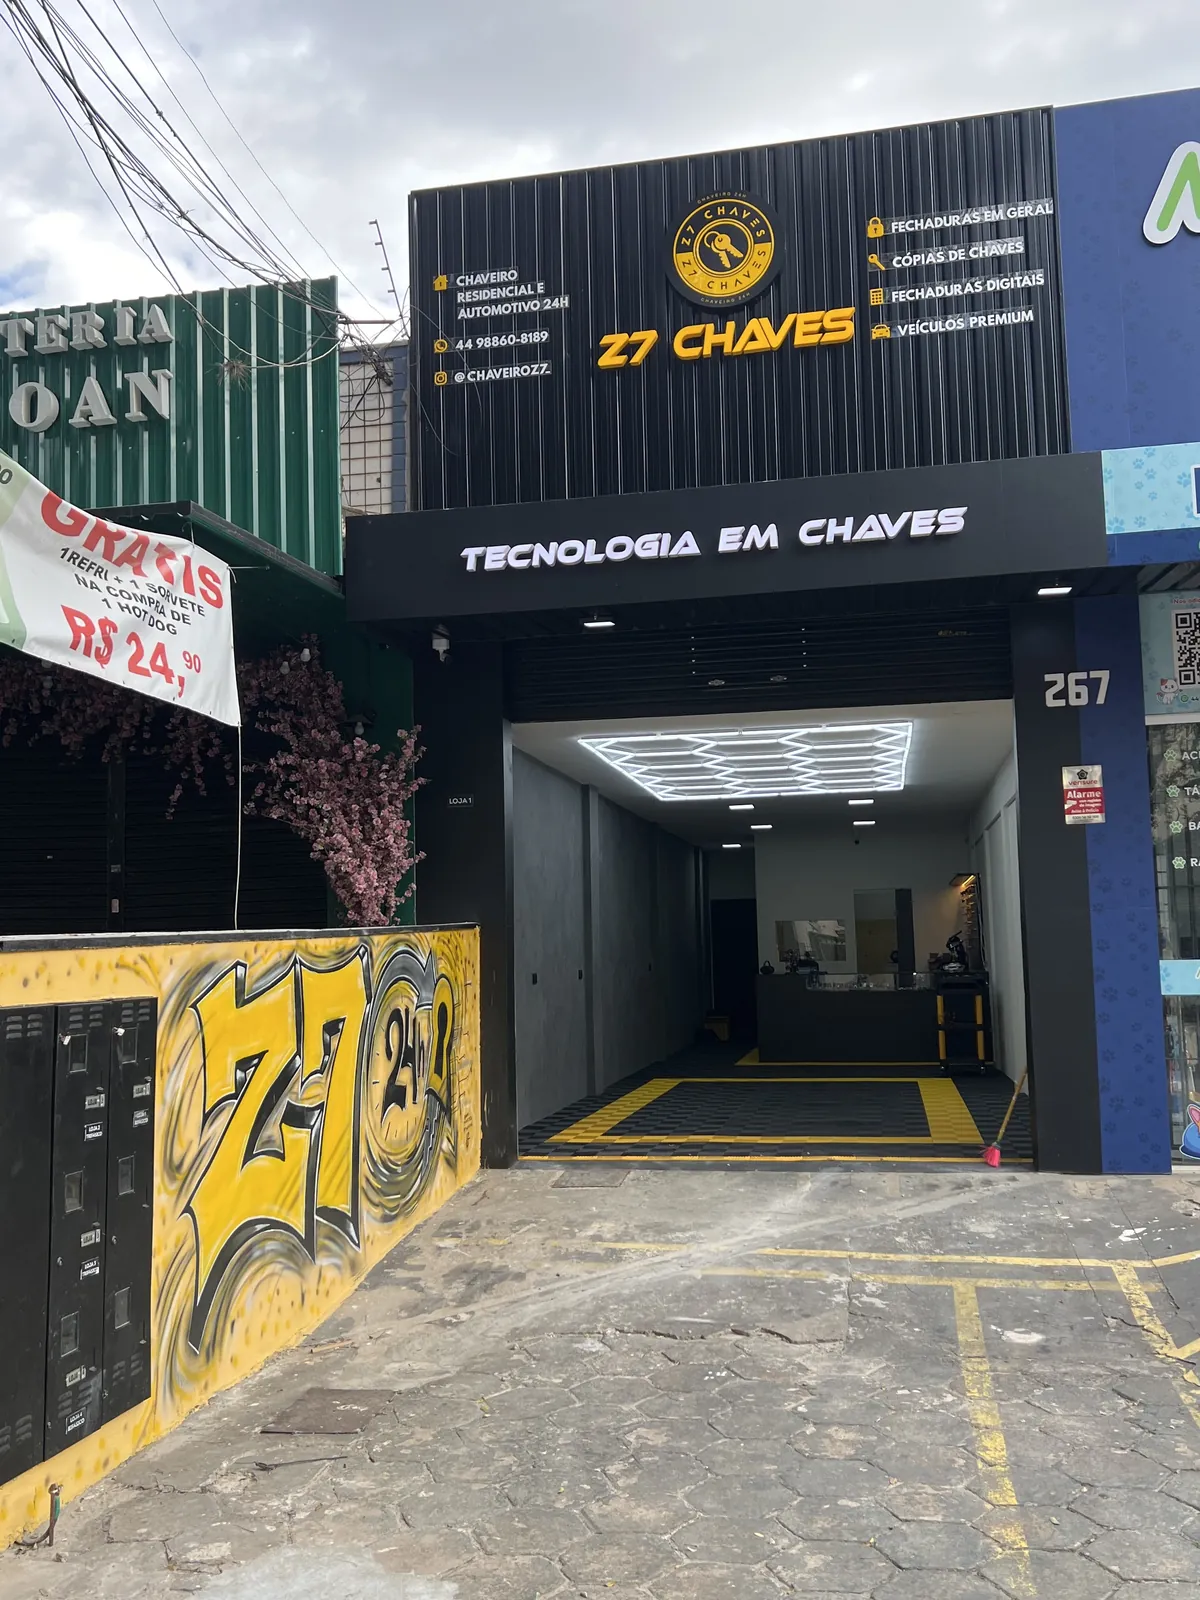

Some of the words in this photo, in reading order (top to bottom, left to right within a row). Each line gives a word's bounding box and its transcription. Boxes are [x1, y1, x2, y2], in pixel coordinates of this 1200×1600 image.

[704, 205, 766, 238] CHAVES
[891, 212, 981, 234] FECHADURAS
[984, 209, 1004, 222] EM
[1006, 203, 1054, 219] GERAL
[706, 250, 766, 290] CHAVES
[892, 252, 945, 268] CÓPIAS
[948, 249, 966, 261] DE
[968, 241, 1025, 259] CHAVES
[456, 269, 518, 287] CHAVEIRO
[457, 284, 535, 304] RESIDENCIAL
[537, 282, 545, 294] E
[891, 281, 983, 303] FECHADURAS
[986, 273, 1045, 292] DIGITAIS
[457, 300, 541, 320] AUTOMOTIVO
[543, 296, 569, 311] 24H
[898, 317, 965, 336] VEÍCULOS
[969, 309, 1034, 328] PREMIUM
[0, 304, 174, 358] TERIA
[455, 339, 474, 351] 44
[476, 330, 549, 349] 98860-8189
[597, 329, 659, 370] Z7
[673, 306, 856, 361] CHAVES
[9, 368, 174, 433] OAN
[460, 530, 701, 572] TECNOLOGIA
[718, 523, 779, 554] EM
[799, 506, 969, 547] CHAVES
[74, 572, 103, 593] NA
[106, 585, 167, 618] COMPRA
[170, 609, 192, 626] DE
[101, 597, 112, 609] 1
[129, 579, 140, 590] 1
[145, 582, 206, 617] SORVETE
[61, 604, 118, 669] R$
[1044, 669, 1110, 708] 267
[449, 797, 468, 805] LOJA
[1067, 790, 1102, 799] Alarme
[177, 945, 372, 1354] Z7
